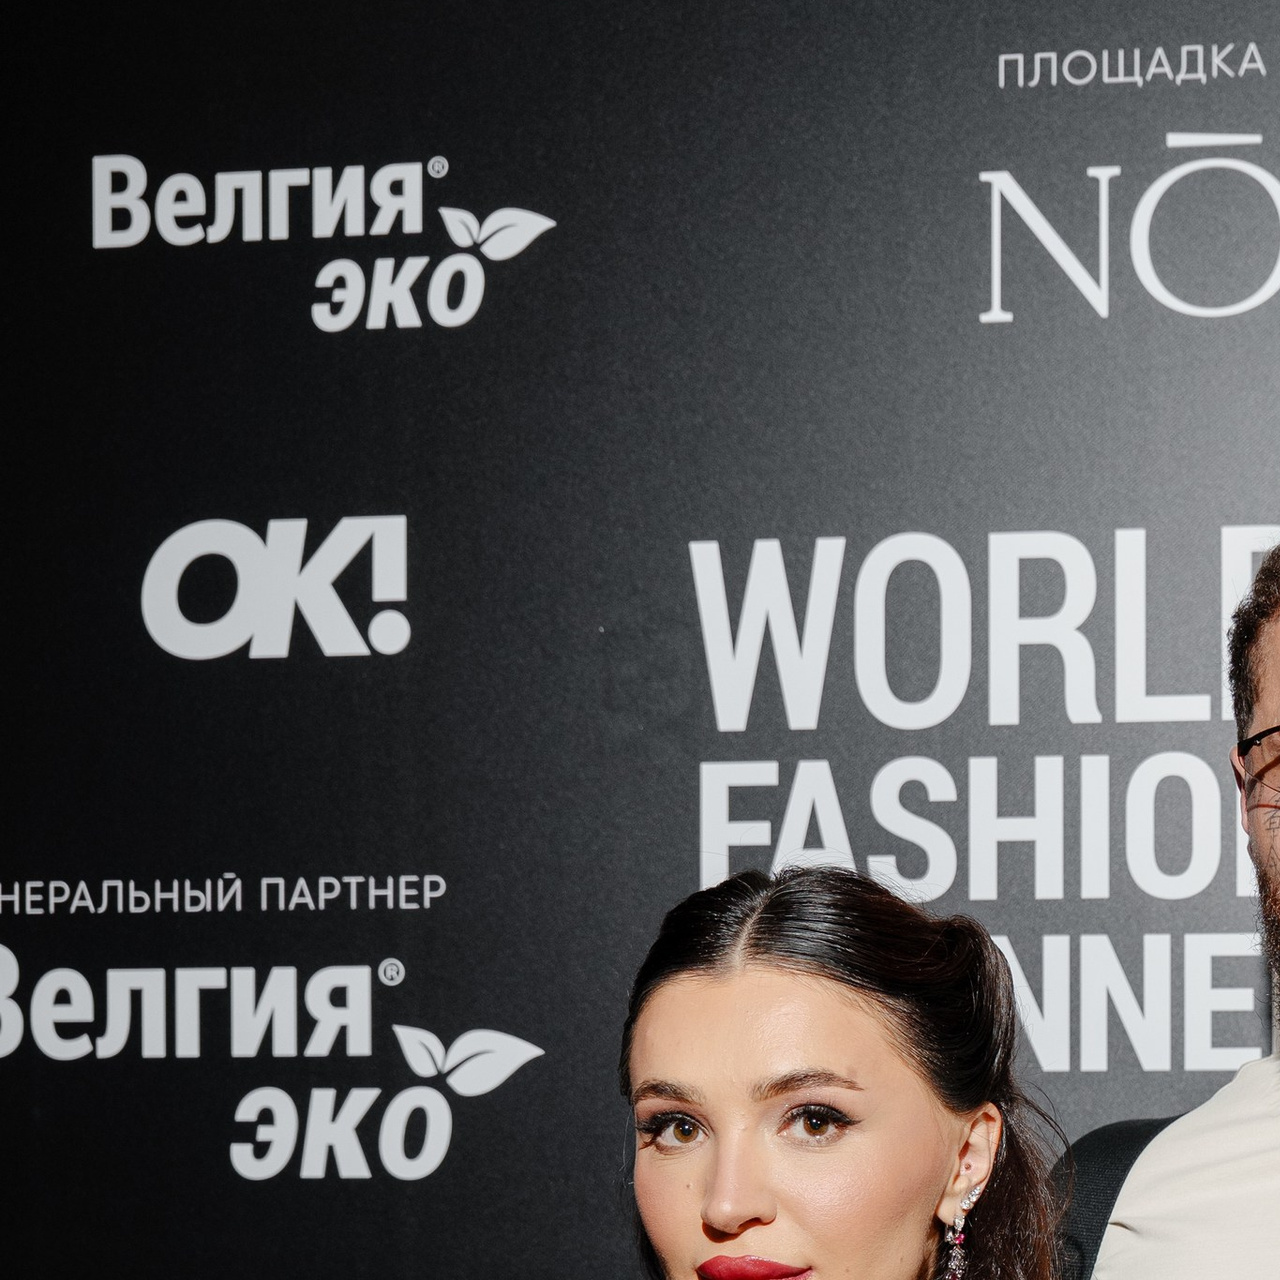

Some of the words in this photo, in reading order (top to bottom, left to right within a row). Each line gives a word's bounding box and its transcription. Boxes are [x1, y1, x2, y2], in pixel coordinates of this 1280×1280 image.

[998, 41, 1267, 89] ПЛОЩАДКА
[140, 514, 412, 661] OK!
[260, 874, 447, 911] ПАРТНЕР
[699, 751, 1262, 902] FASHIO
[990, 933, 1263, 1073] NNE
